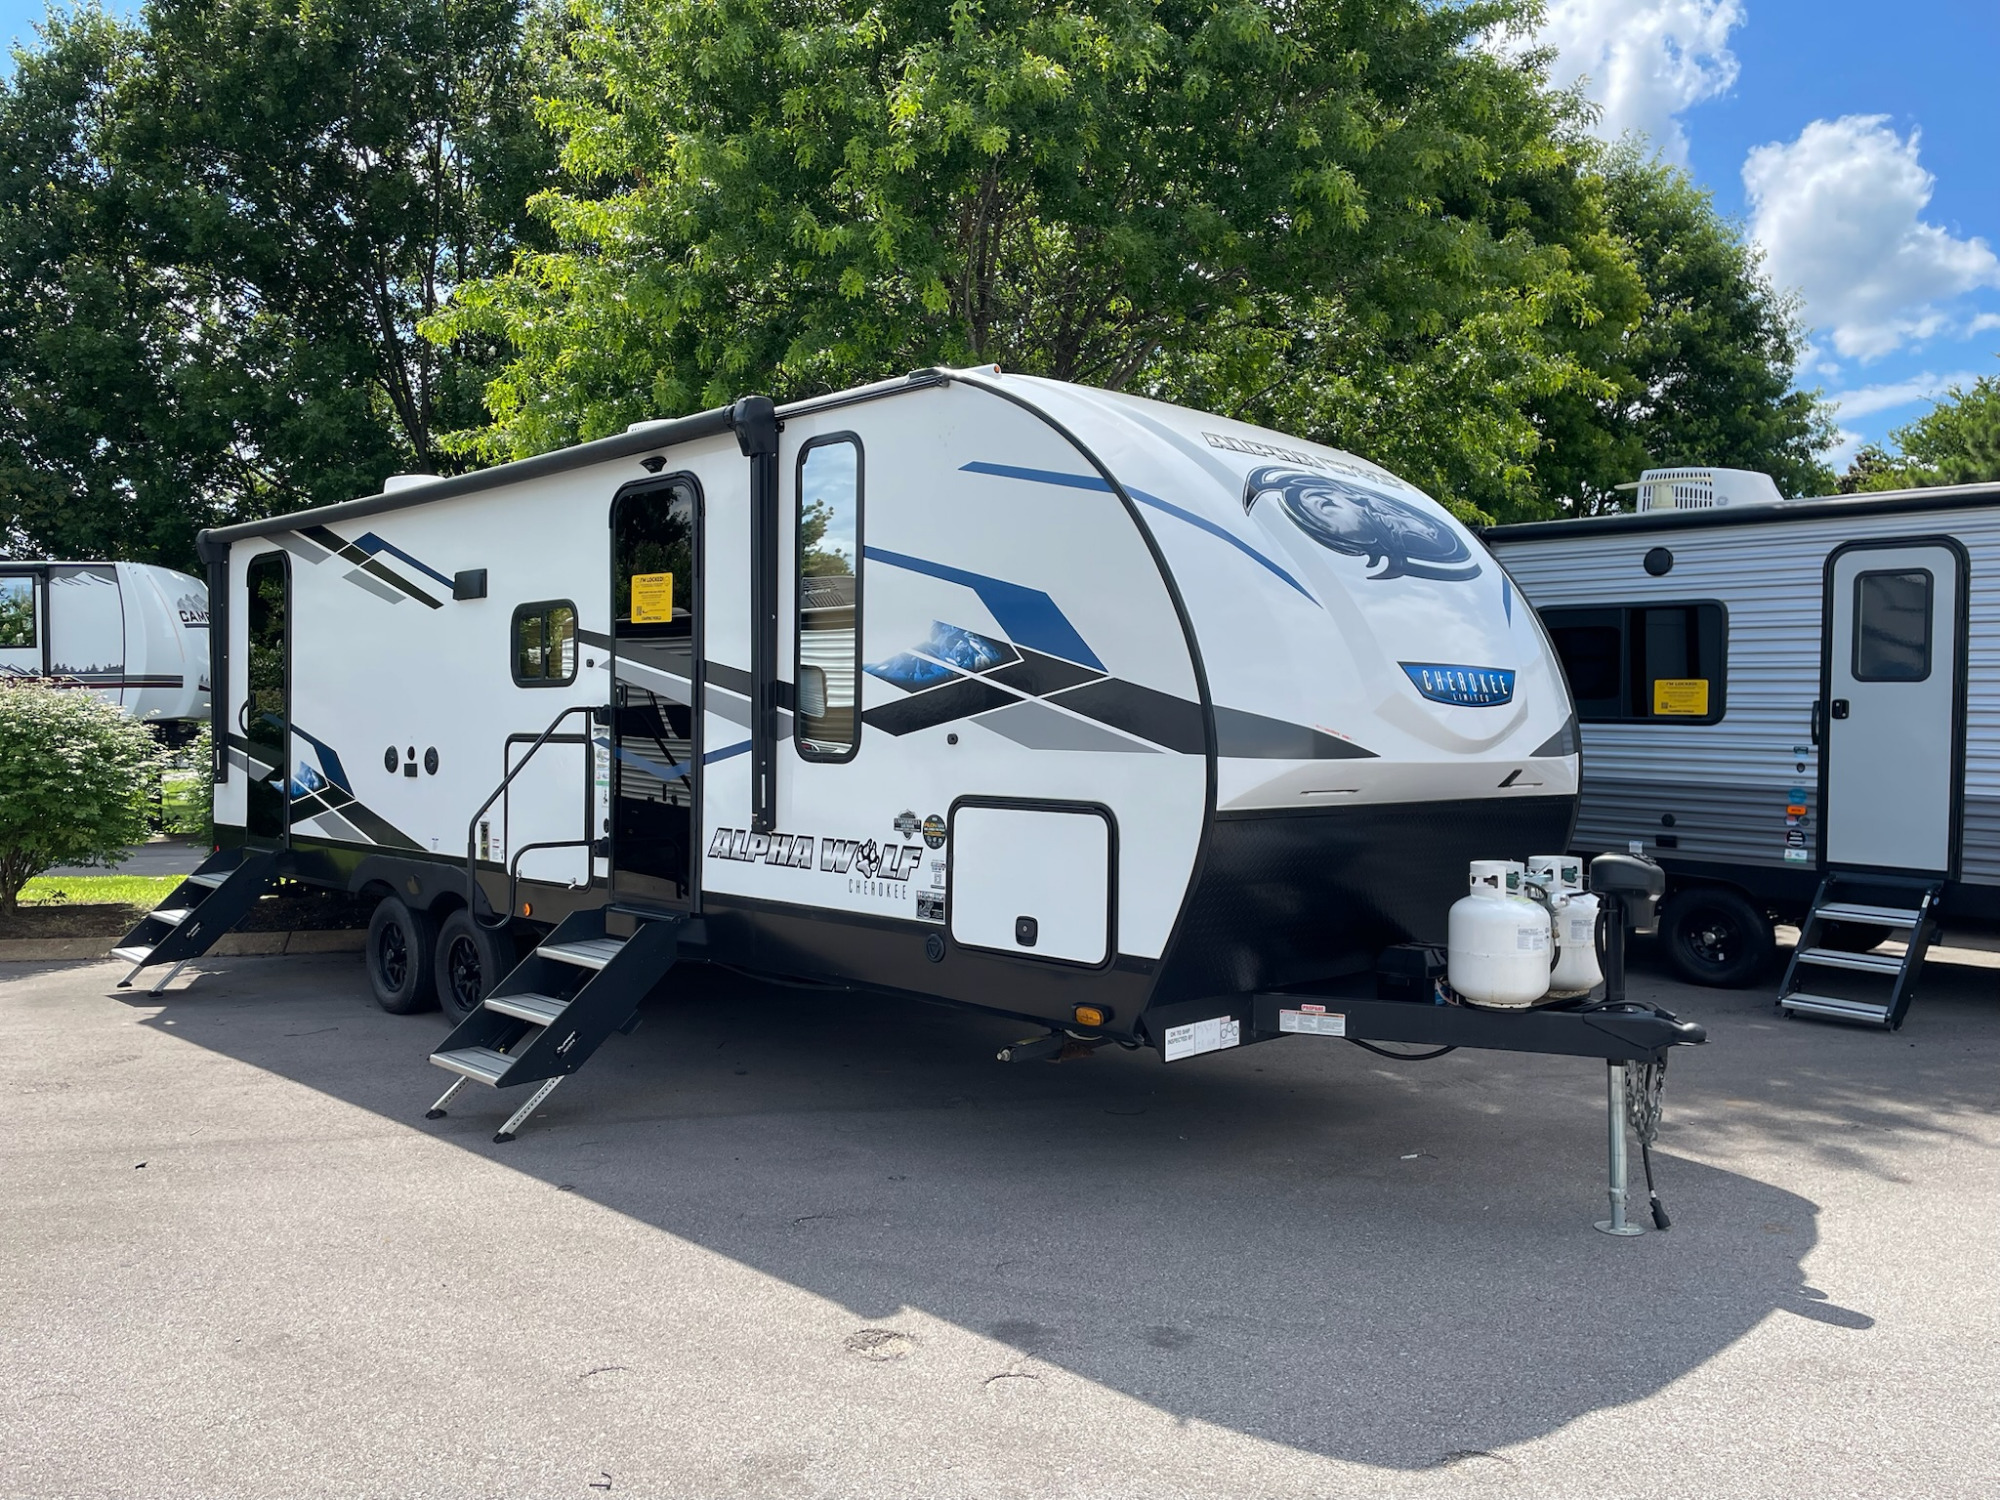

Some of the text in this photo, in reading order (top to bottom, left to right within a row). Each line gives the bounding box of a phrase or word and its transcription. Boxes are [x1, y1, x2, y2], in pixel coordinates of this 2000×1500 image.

[1201, 431, 1326, 470] ALPHA
[1422, 669, 1508, 695] CHEROKEE
[1452, 693, 1490, 702] LIMITED
[707, 827, 815, 869] ALPHA
[848, 878, 907, 900] CHEROKEE
